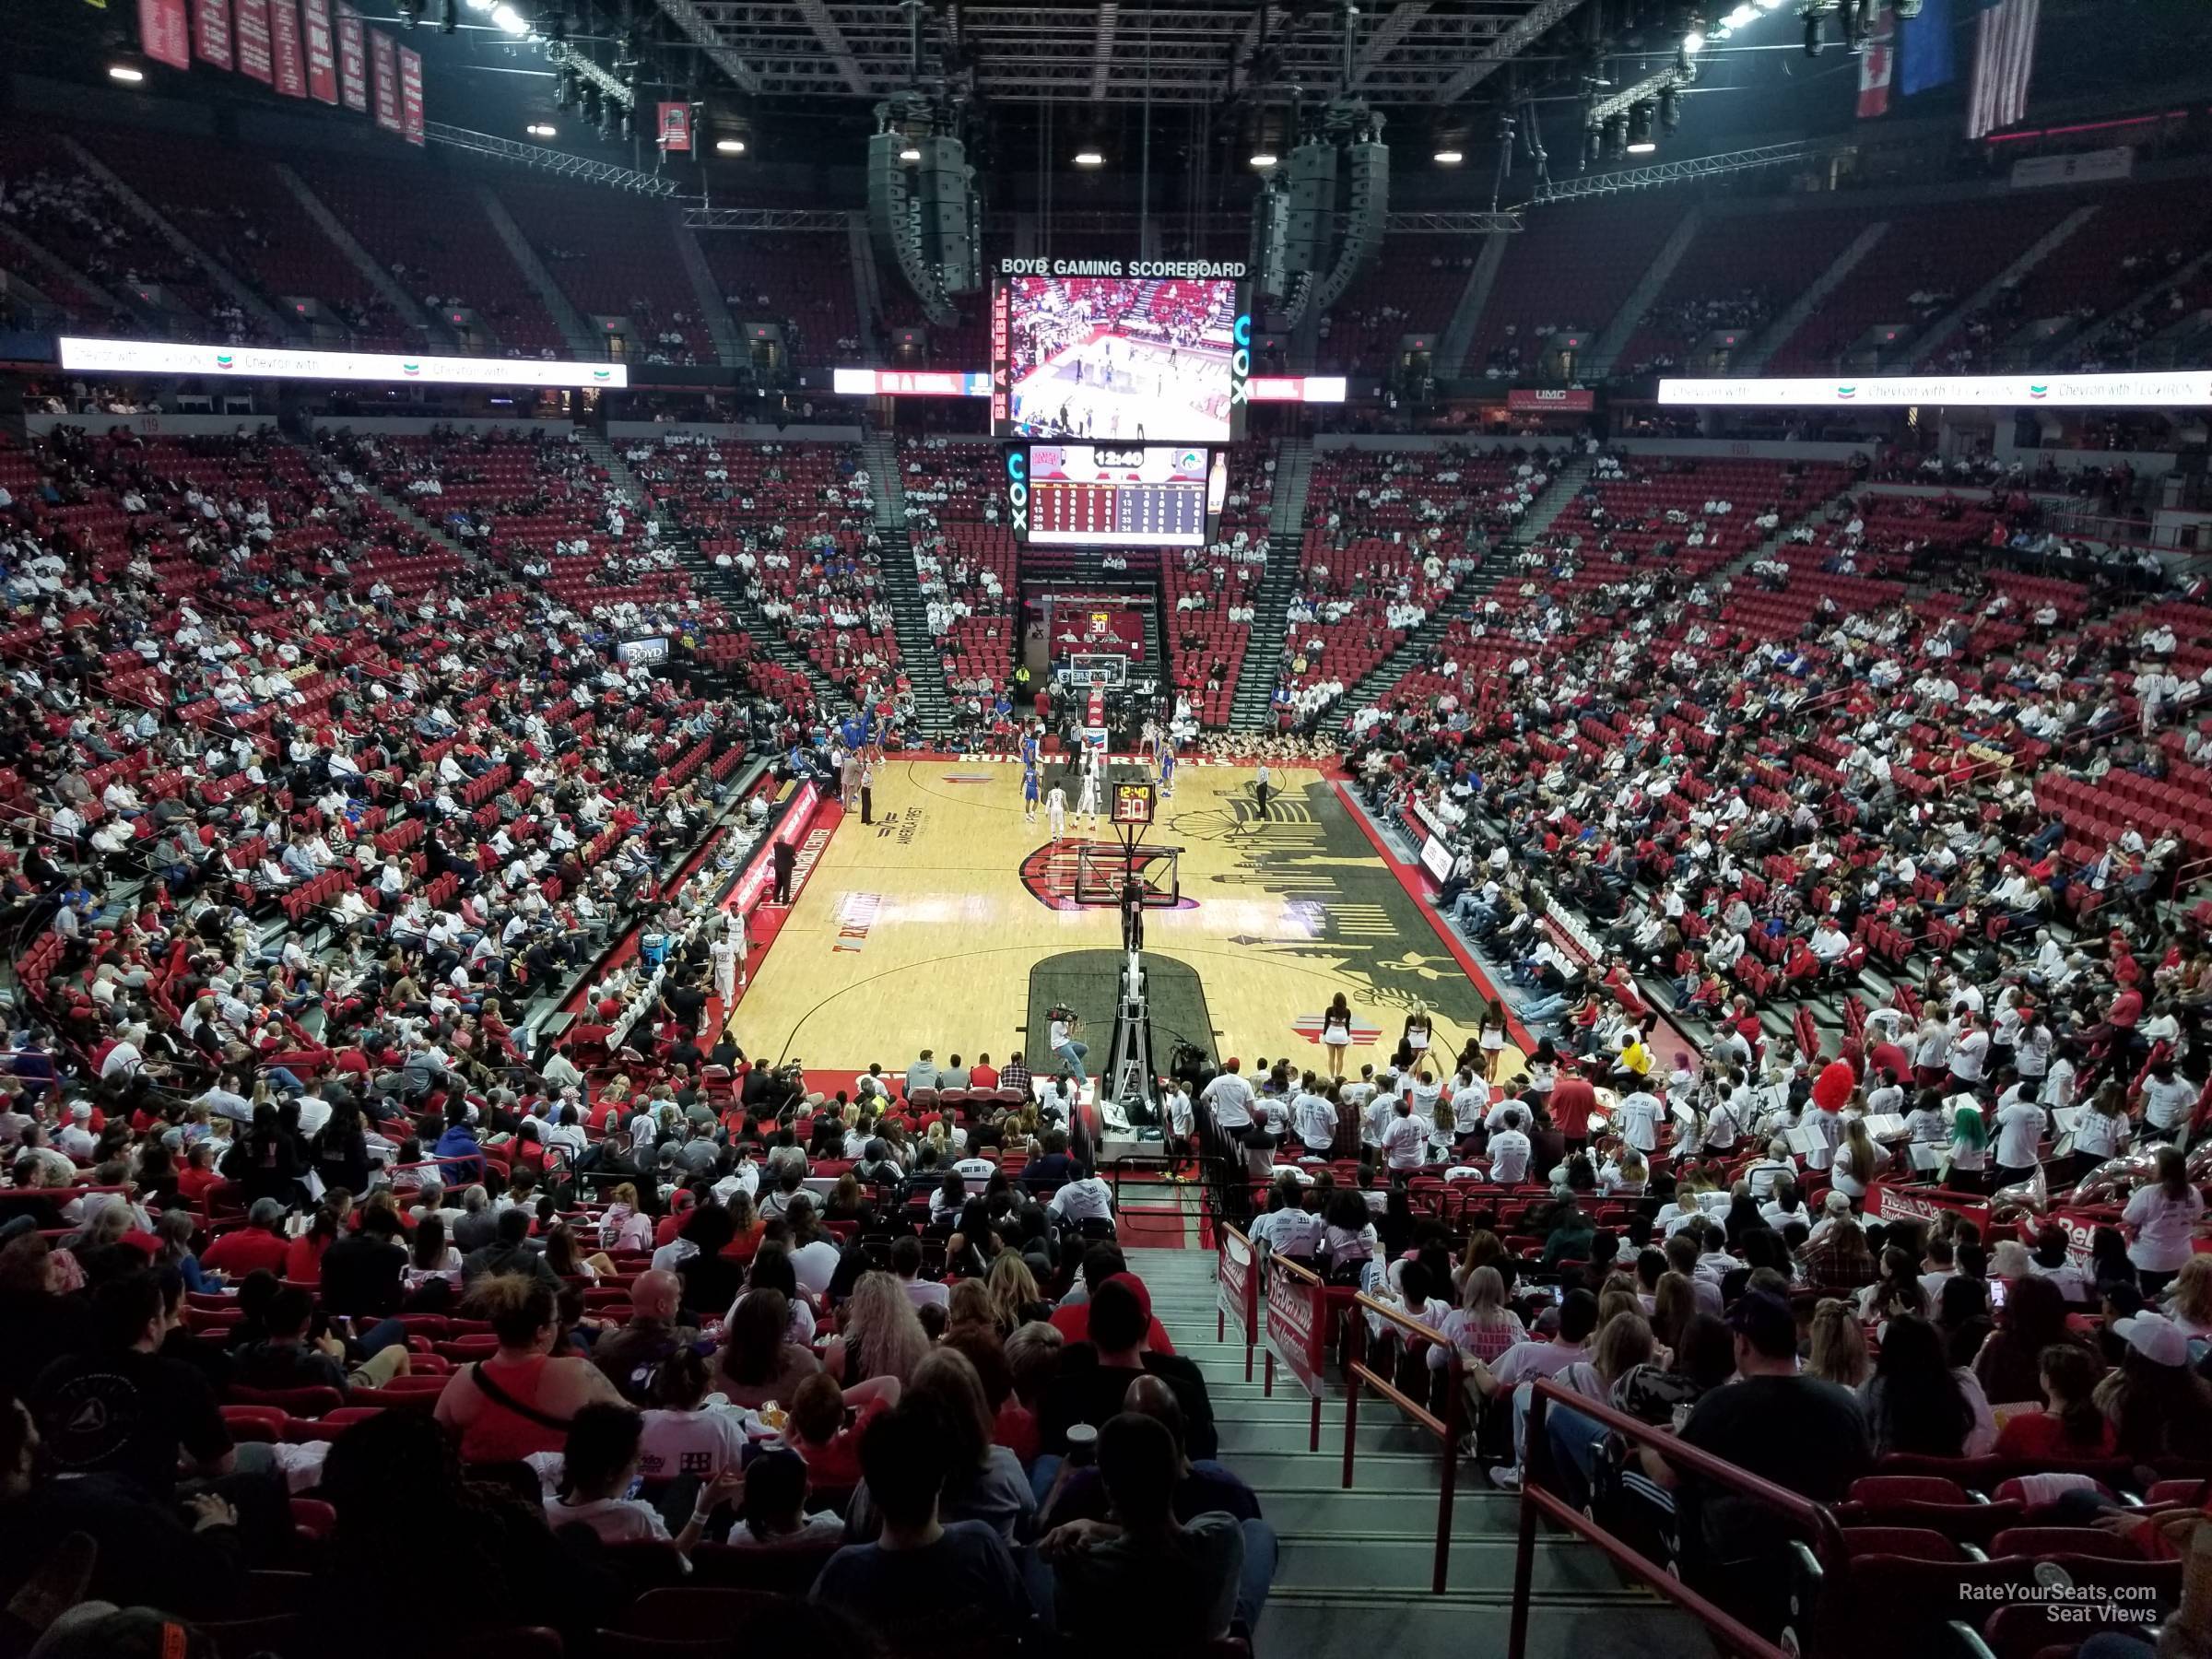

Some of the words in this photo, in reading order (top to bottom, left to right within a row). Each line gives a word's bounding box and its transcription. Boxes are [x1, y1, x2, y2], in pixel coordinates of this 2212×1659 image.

[1002, 259, 1048, 274] BOYD
[1054, 261, 1122, 276] GAMING
[1129, 262, 1246, 277] SCOREBOARD
[994, 288, 1006, 360] REBEL.
[1231, 315, 1251, 405] COX
[995, 369, 1006, 385] A
[1535, 390, 1566, 400] UMC
[1867, 383, 1917, 397] Chevron
[1921, 382, 1946, 397] with
[2059, 382, 2106, 397] Chevron
[2109, 381, 2130, 396] with
[994, 393, 1006, 419] BE
[1095, 451, 1143, 466] 12:40
[1008, 453, 1027, 531] COX
[1092, 621, 1105, 632] 30
[1110, 757, 1235, 767] REELS
[1120, 786, 1148, 798] 12:40
[1121, 798, 1144, 818] 30
[895, 821, 918, 845] AMERICA
